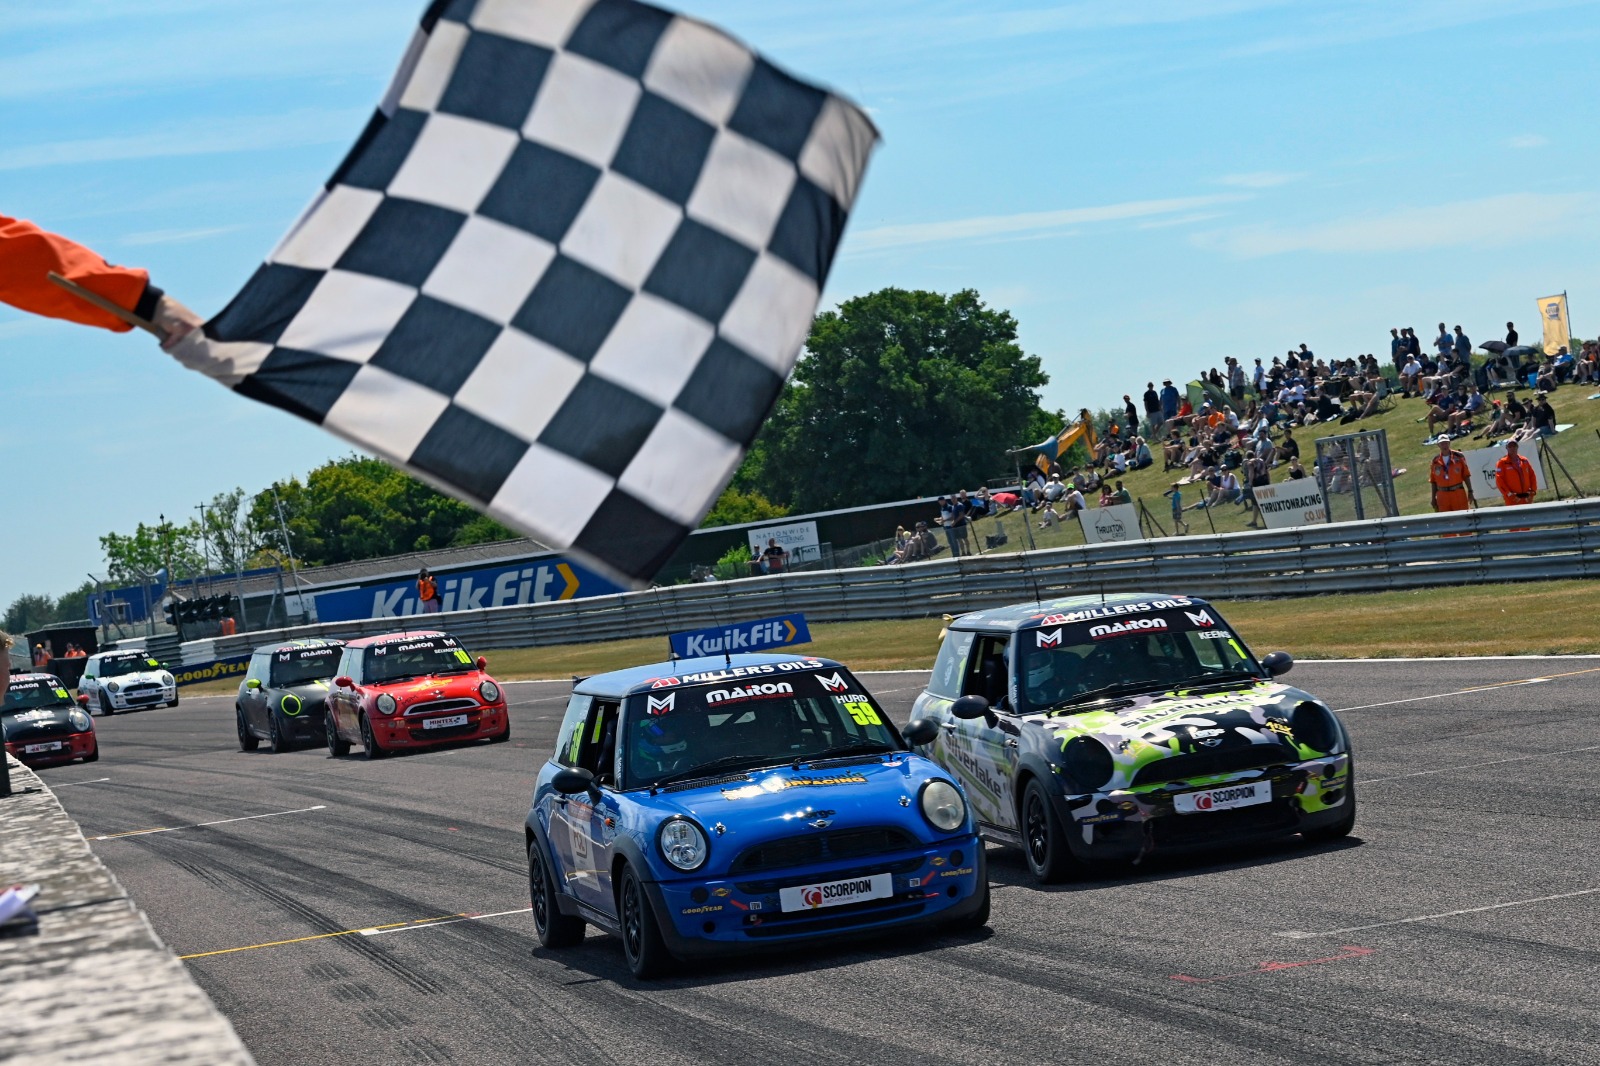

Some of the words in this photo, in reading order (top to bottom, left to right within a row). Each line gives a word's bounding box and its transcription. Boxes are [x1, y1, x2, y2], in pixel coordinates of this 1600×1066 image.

[1259, 493, 1322, 514] THRUXTONRACING
[756, 526, 810, 540] NATIONWIDE
[1095, 524, 1124, 535] THRUXTON
[1070, 602, 1152, 620] MILLERS
[1152, 598, 1193, 609] OILS
[1198, 630, 1232, 640] KEENS
[1227, 638, 1248, 660] 1
[682, 664, 776, 684] MILLERS
[778, 660, 824, 672] OILS
[835, 693, 869, 704] HURD
[843, 702, 883, 726] 59
[1212, 785, 1256, 804] SCORPION
[823, 879, 872, 899] SCORPION
[682, 905, 723, 914] GOODYEAR
